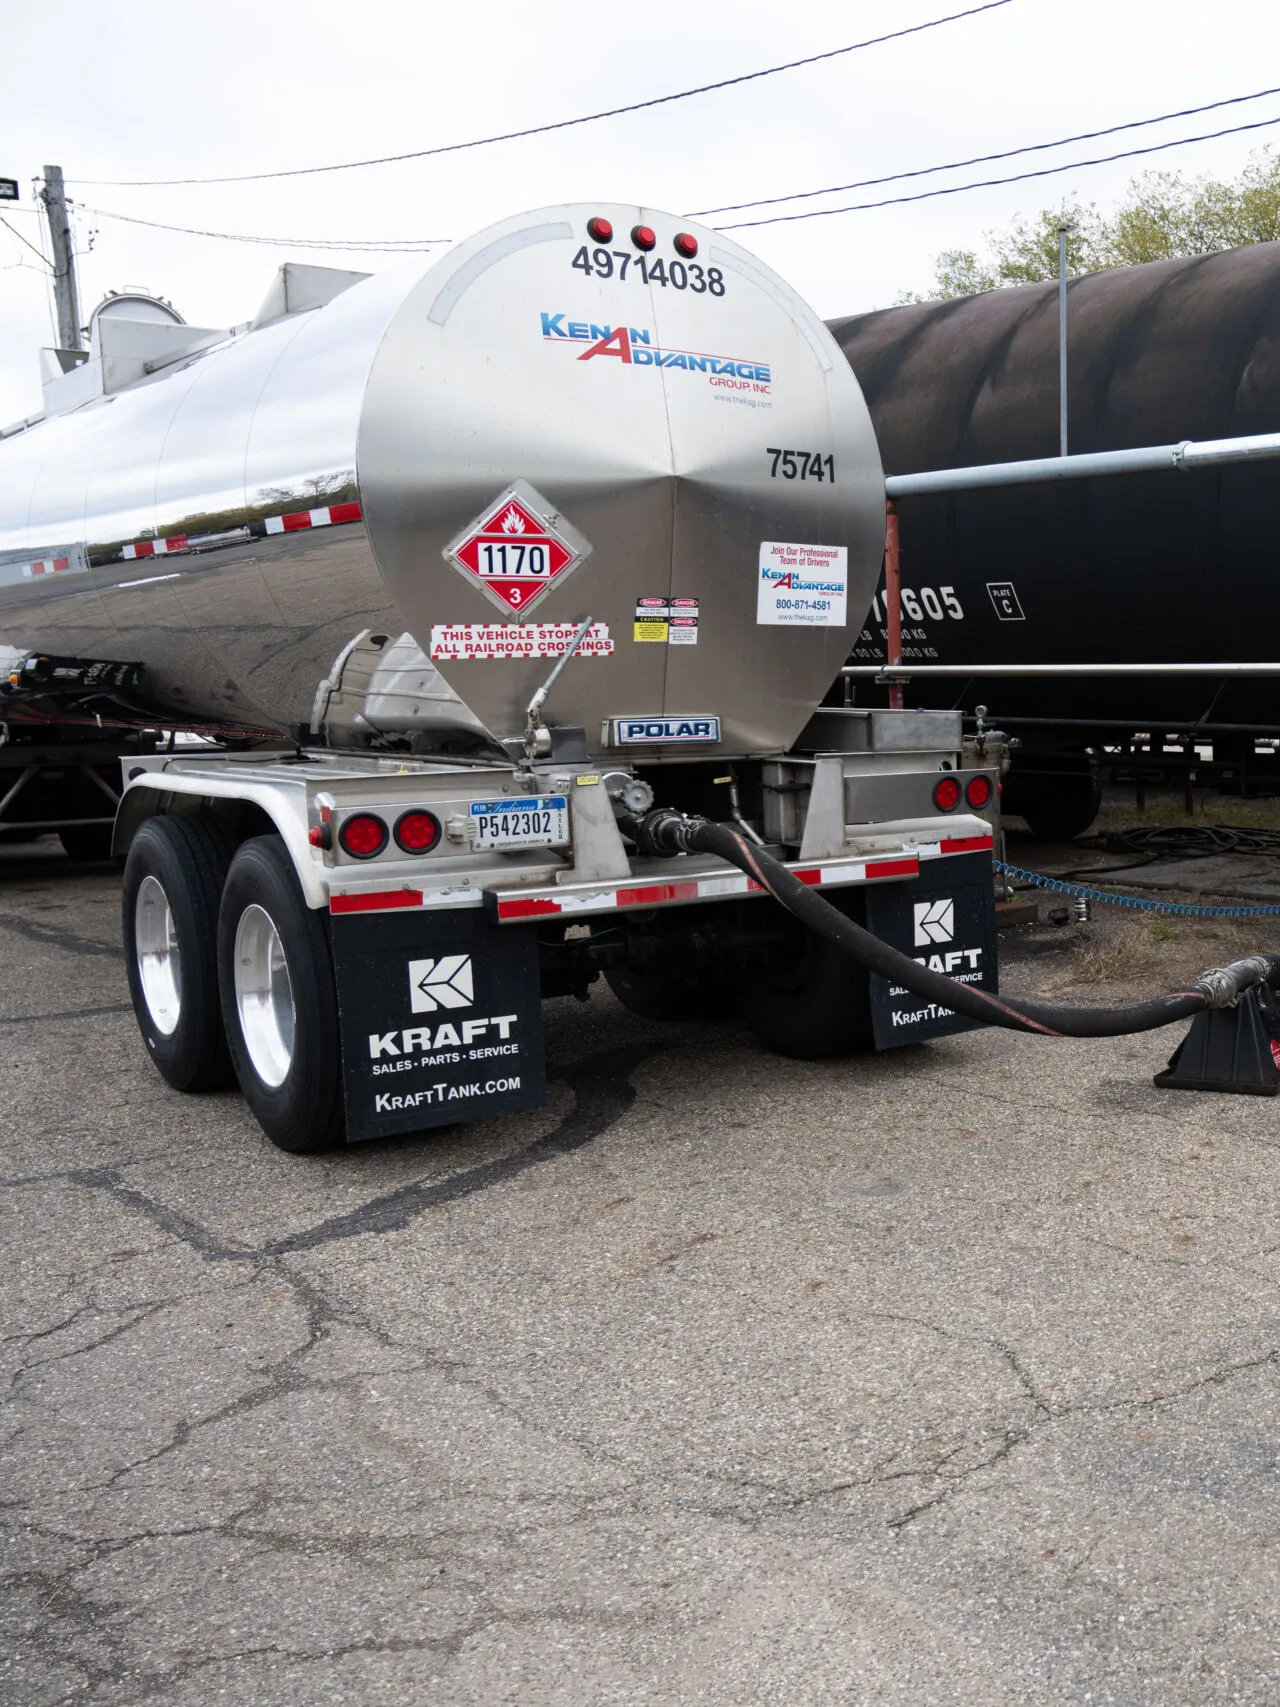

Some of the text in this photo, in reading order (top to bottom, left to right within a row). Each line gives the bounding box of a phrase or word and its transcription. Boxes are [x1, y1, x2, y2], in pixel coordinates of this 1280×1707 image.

[571, 245, 726, 297] 49714038
[540, 312, 651, 345] KENAN
[576, 326, 772, 383] ADVANTAGE
[766, 447, 835, 484] 75741
[483, 544, 545, 574] 1170
[771, 546, 839, 559] Join Our Professional
[779, 555, 830, 567] Team of Drivers
[761, 567, 800, 580] KENAN
[772, 572, 845, 592] ADVANTAGE
[509, 588, 522, 604] 3
[992, 589, 1011, 597] PLATE
[776, 598, 831, 611] 800-871-4581
[1002, 599, 1013, 614] C
[441, 631, 473, 641] THIS
[477, 630, 535, 641] VEHICLE
[585, 629, 600, 639] AT
[911, 629, 927, 640] KG
[434, 640, 612, 654] ALL RAILROAD CROSSINGS
[871, 648, 884, 658] LB
[922, 647, 938, 657] KG
[627, 722, 711, 738] POLAR
[491, 800, 536, 813] Indiana
[479, 811, 552, 839] P542302
[368, 1014, 518, 1059] KRAFT
[372, 1043, 519, 1076] SALES PARTS SERVICE
